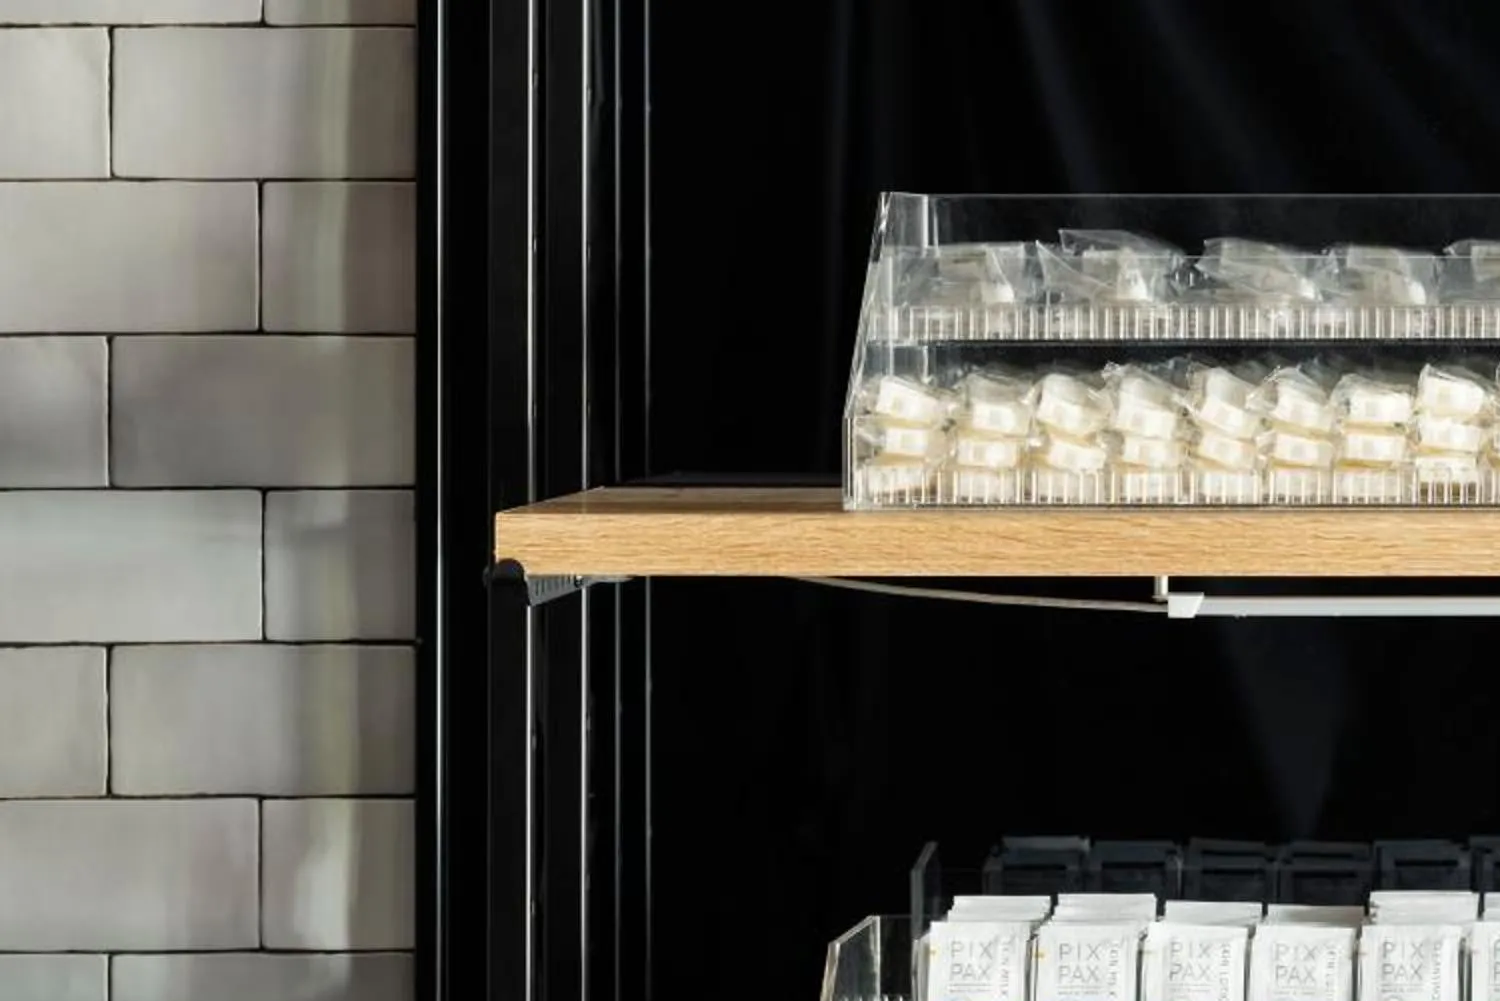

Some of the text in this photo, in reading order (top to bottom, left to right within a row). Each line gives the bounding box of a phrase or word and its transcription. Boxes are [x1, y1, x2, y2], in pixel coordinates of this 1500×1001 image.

[950, 940, 994, 960] PIX
[1058, 942, 1101, 961] PIX
[1170, 941, 1213, 959] PIX
[1274, 942, 1318, 962] PIX
[1382, 941, 1424, 959] PIX
[949, 962, 992, 981] PAX
[1058, 965, 1100, 984] PAX
[1169, 963, 1212, 981] PAX
[1274, 964, 1317, 983] PAX
[1381, 962, 1423, 981] PAX
